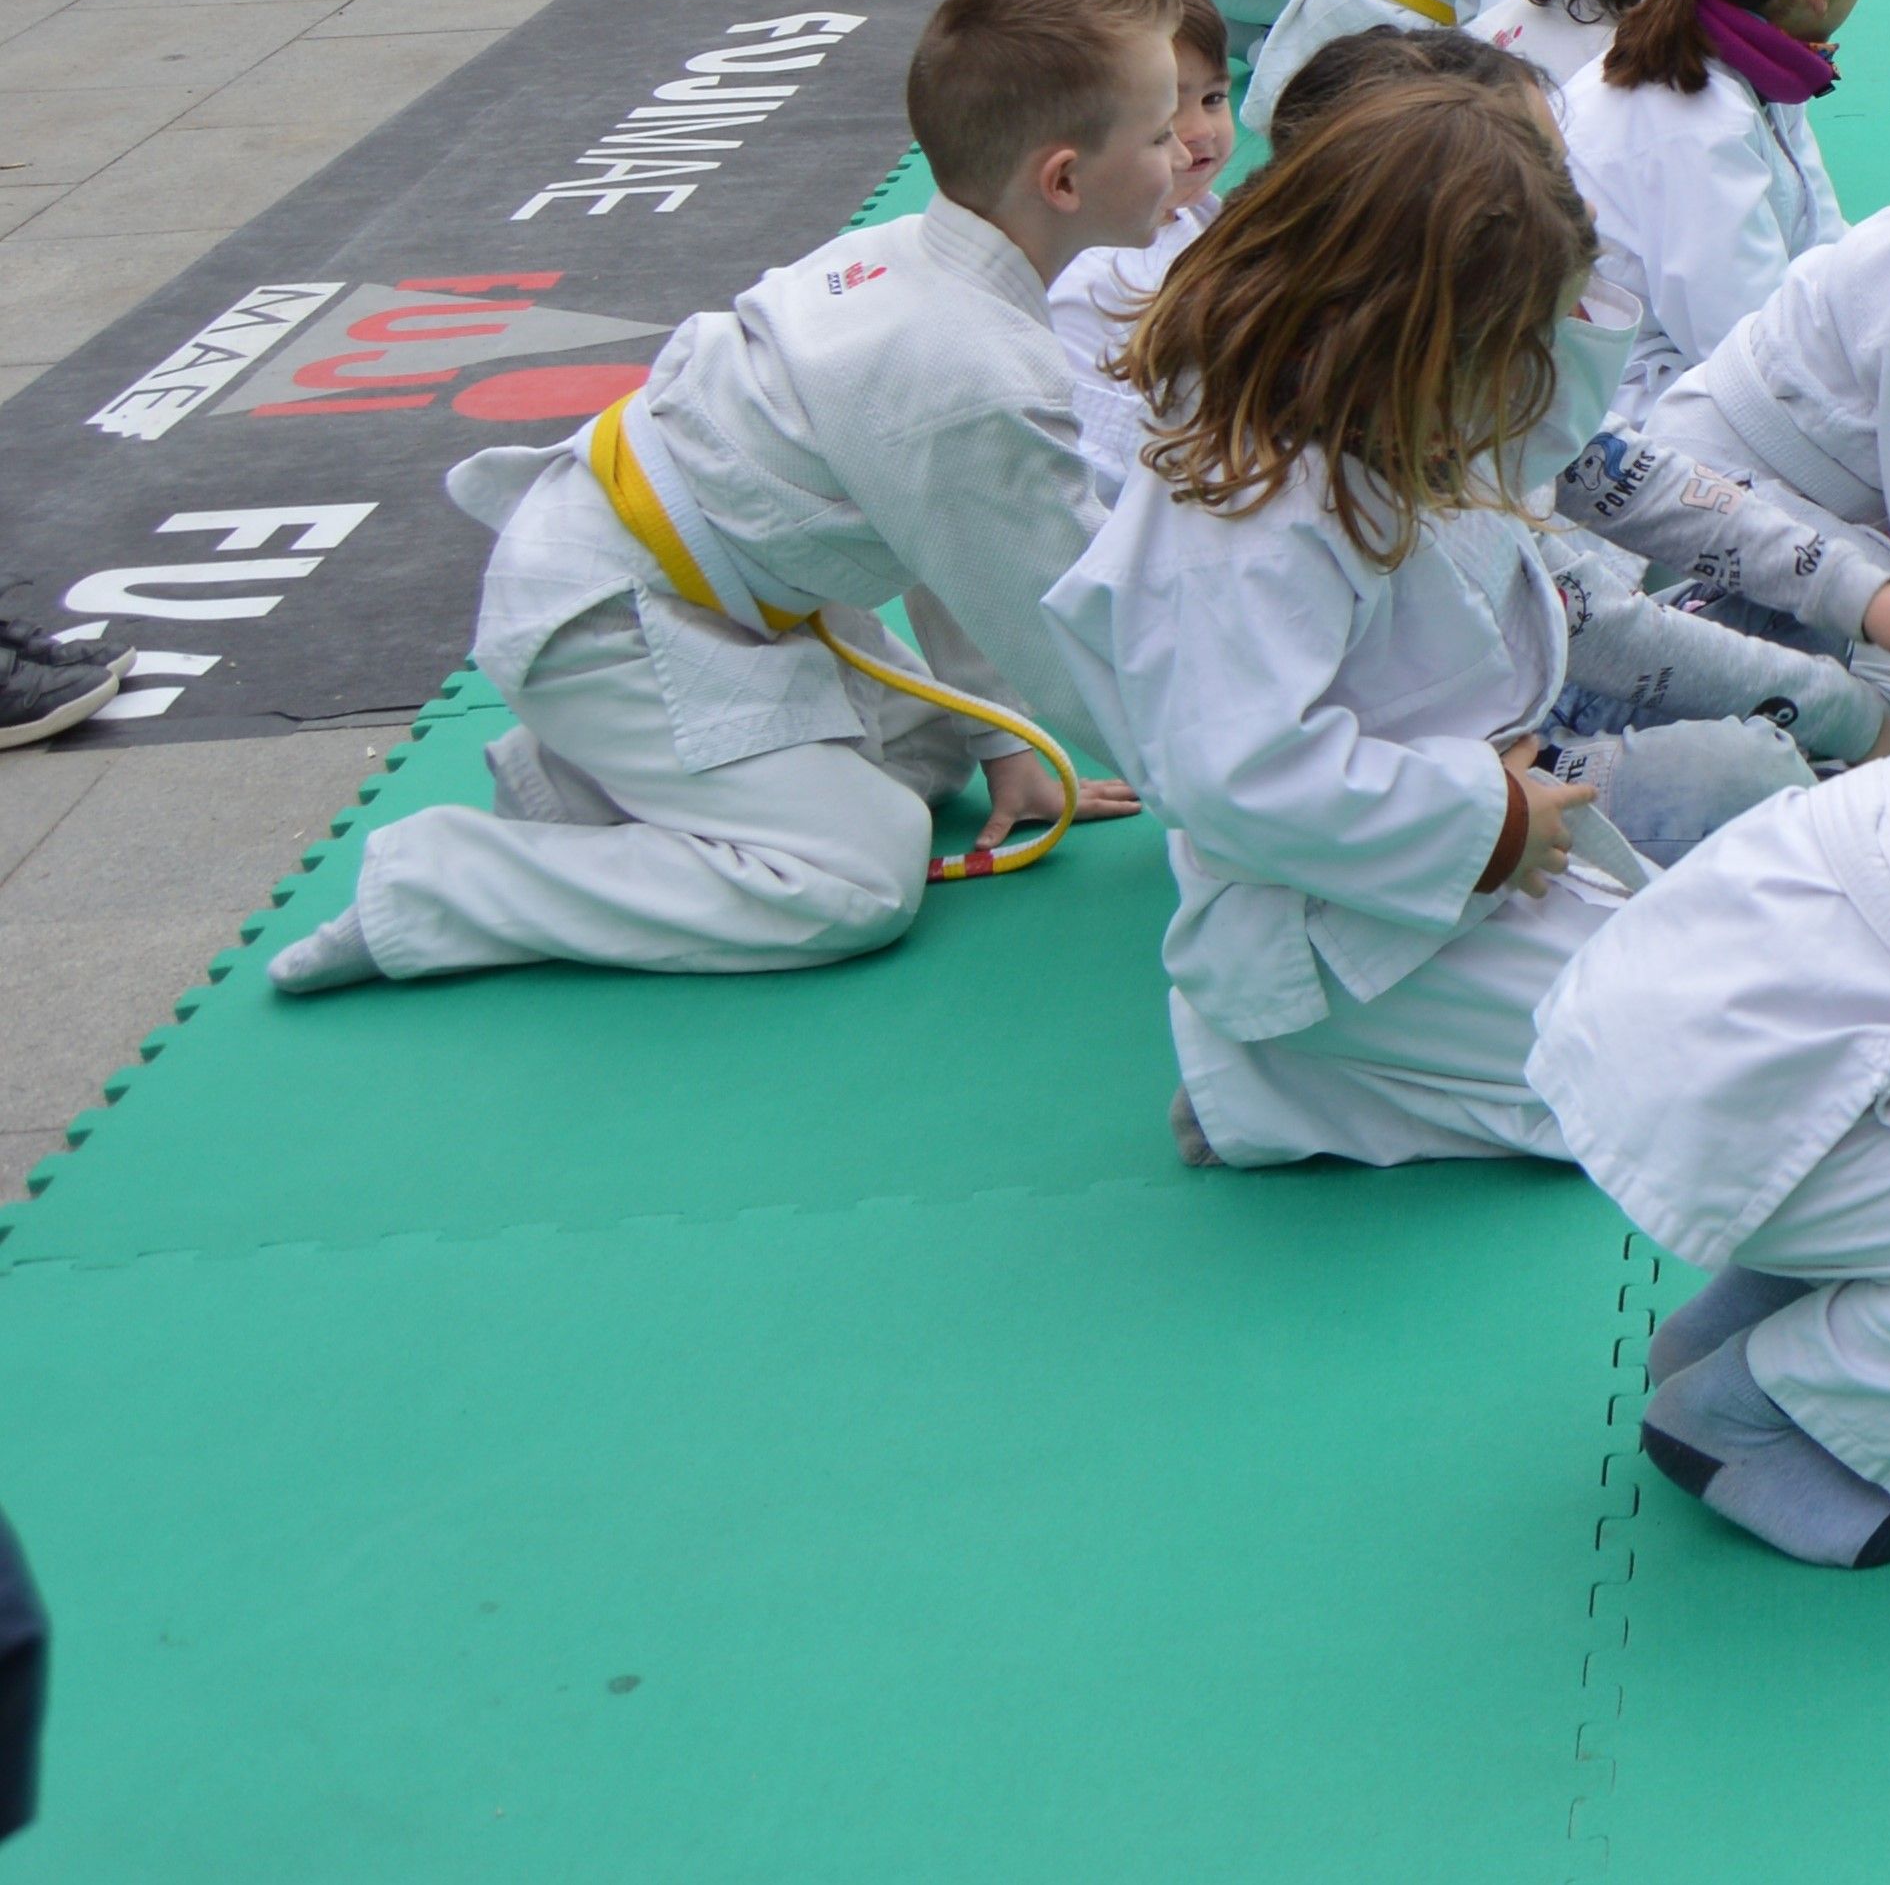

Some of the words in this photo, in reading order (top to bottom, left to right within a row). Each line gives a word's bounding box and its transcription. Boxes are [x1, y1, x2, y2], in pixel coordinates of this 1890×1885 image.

[510, 11, 868, 221] FUJIMAE
[107, 288, 328, 415] MAE
[251, 271, 567, 418] FUJI
[1594, 450, 1656, 516] POWERS
